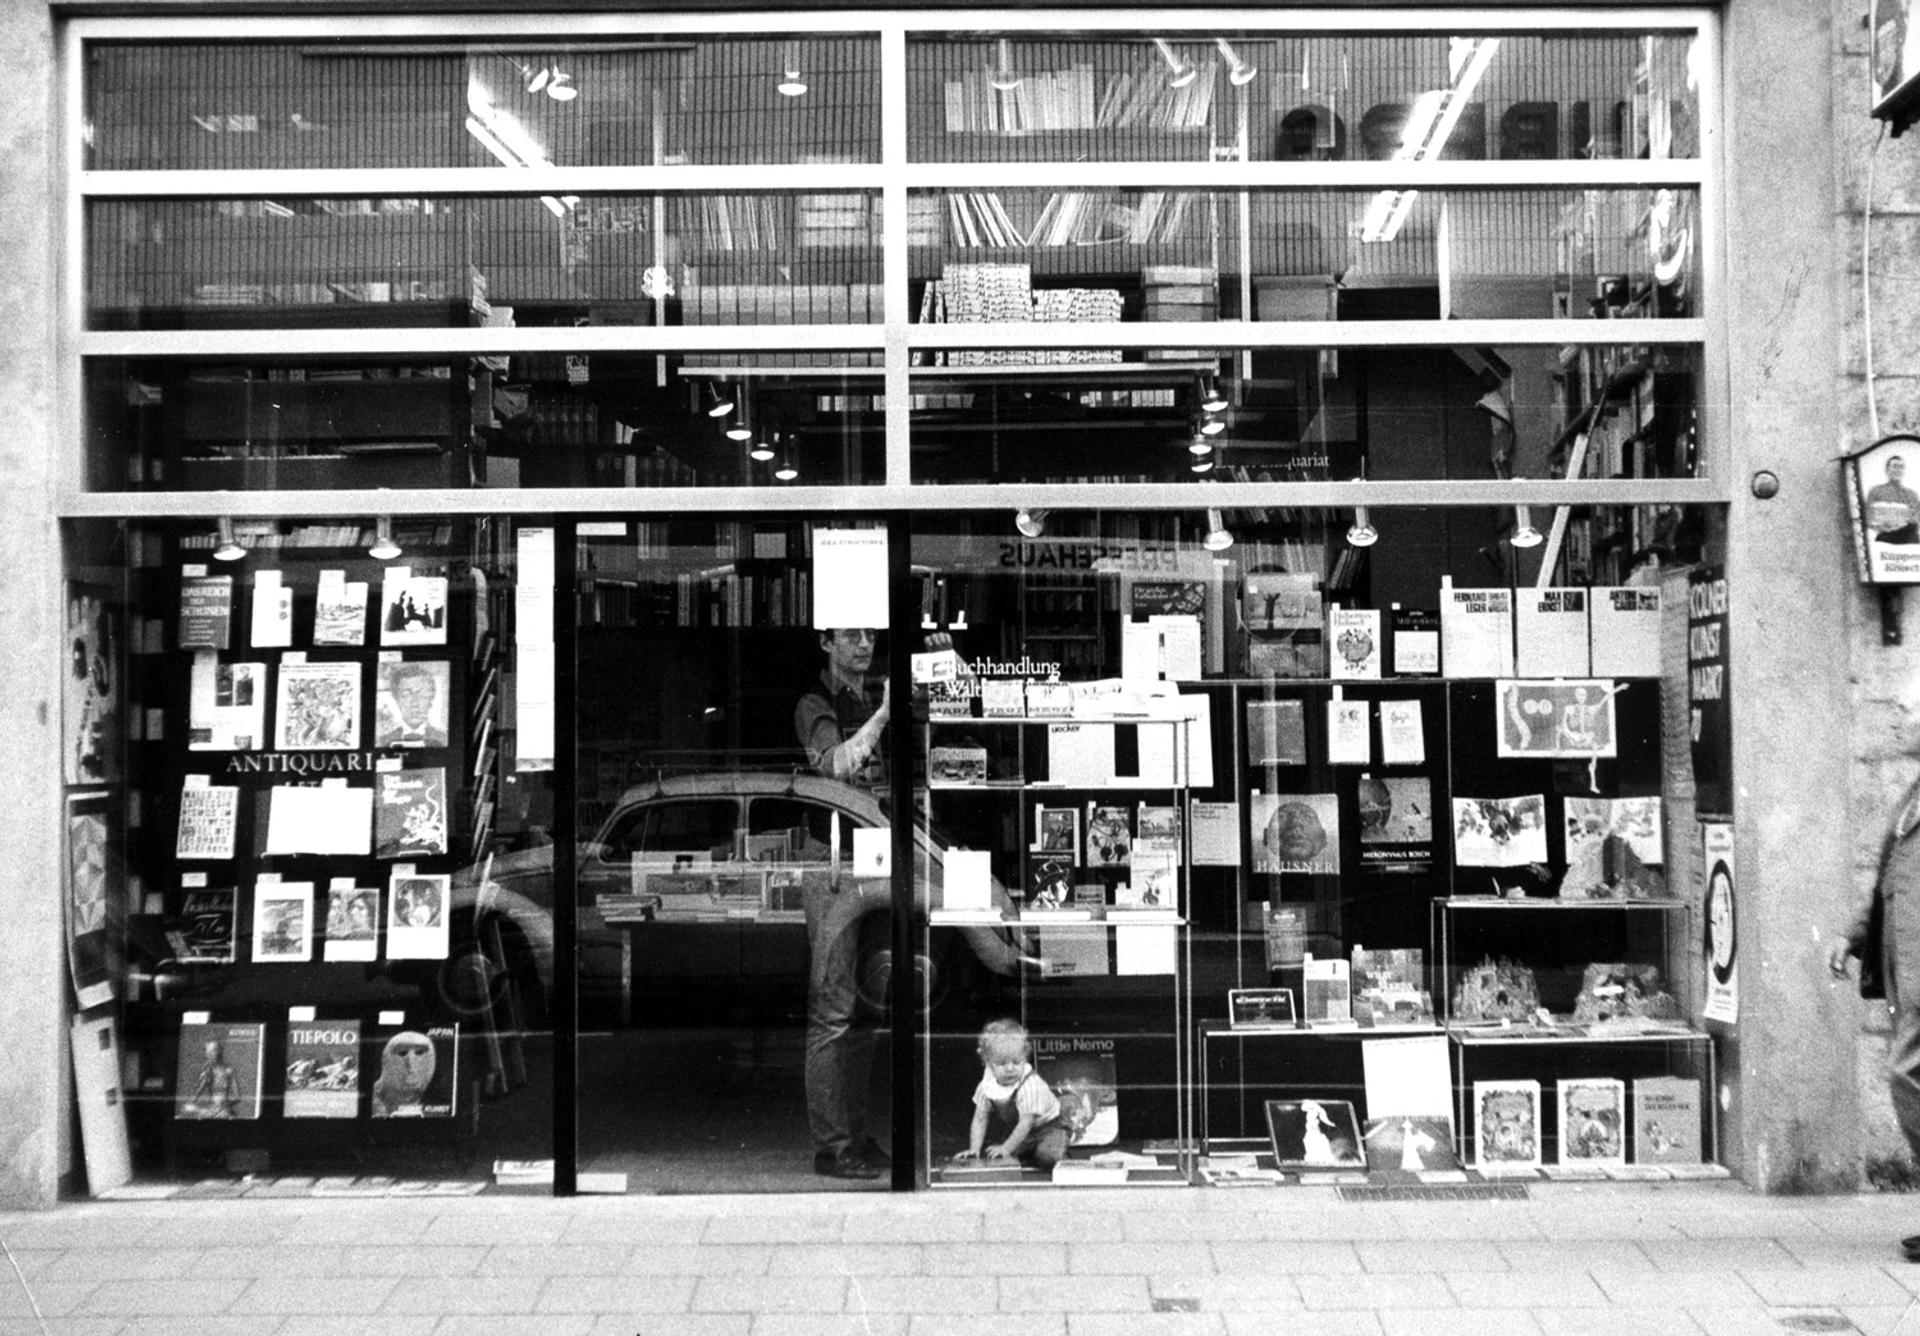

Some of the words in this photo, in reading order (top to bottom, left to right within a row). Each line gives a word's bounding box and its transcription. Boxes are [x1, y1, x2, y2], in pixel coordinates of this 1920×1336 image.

[943, 679, 986, 698] Walt
[226, 752, 409, 775] ANTIQUARI
[1256, 860, 1334, 874] HAUSNER
[291, 1030, 357, 1045] TIEPOLO
[1038, 1039, 1072, 1053] Little
[1073, 1037, 1114, 1051] Nemo
